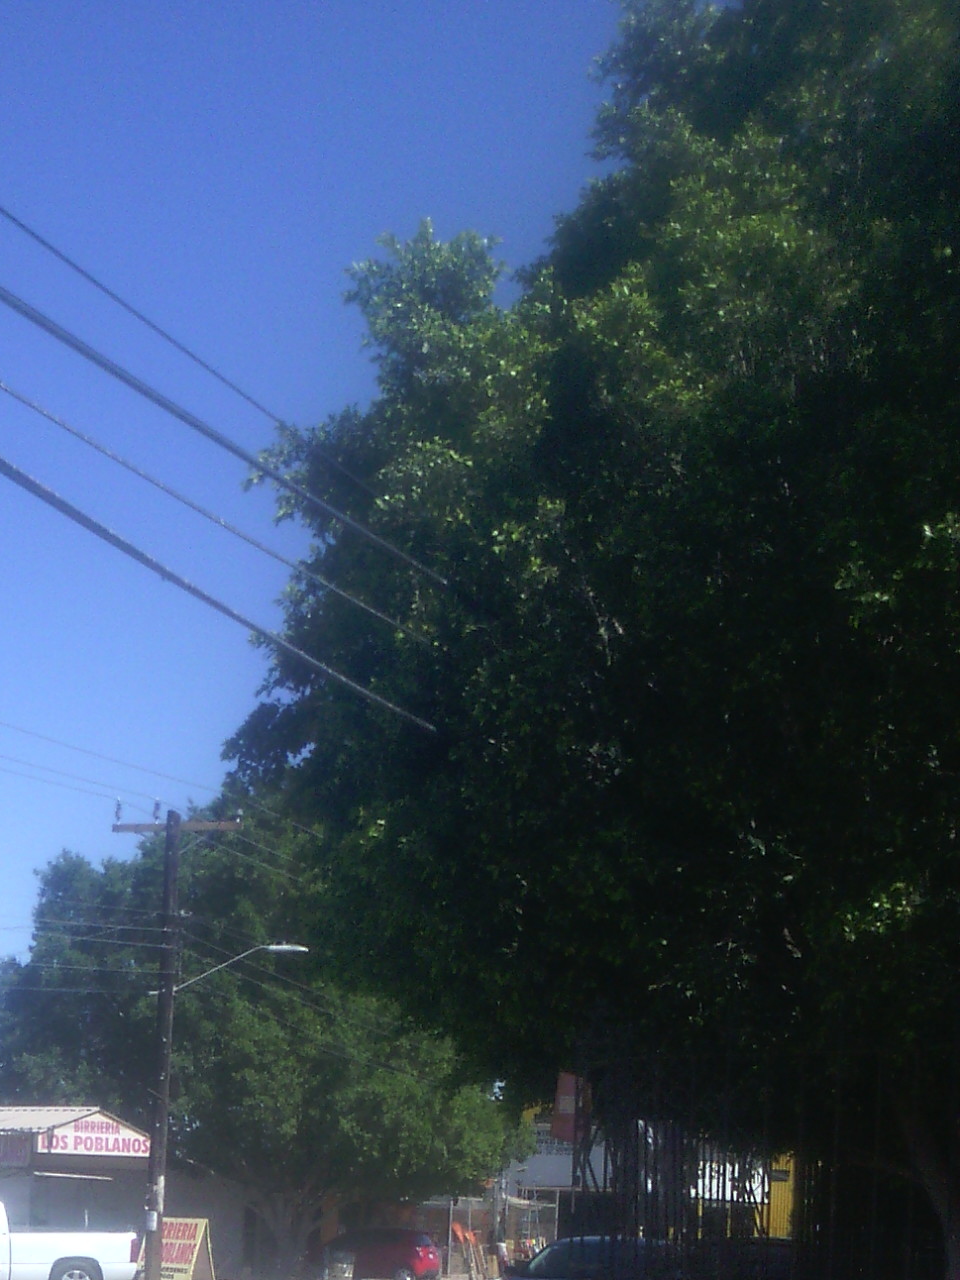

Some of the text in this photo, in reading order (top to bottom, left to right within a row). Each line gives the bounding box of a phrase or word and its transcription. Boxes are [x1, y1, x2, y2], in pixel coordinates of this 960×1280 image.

[73, 1120, 121, 1136] BIRRIERIA
[41, 1133, 68, 1151] LOS
[73, 1135, 150, 1155] POBLANOS
